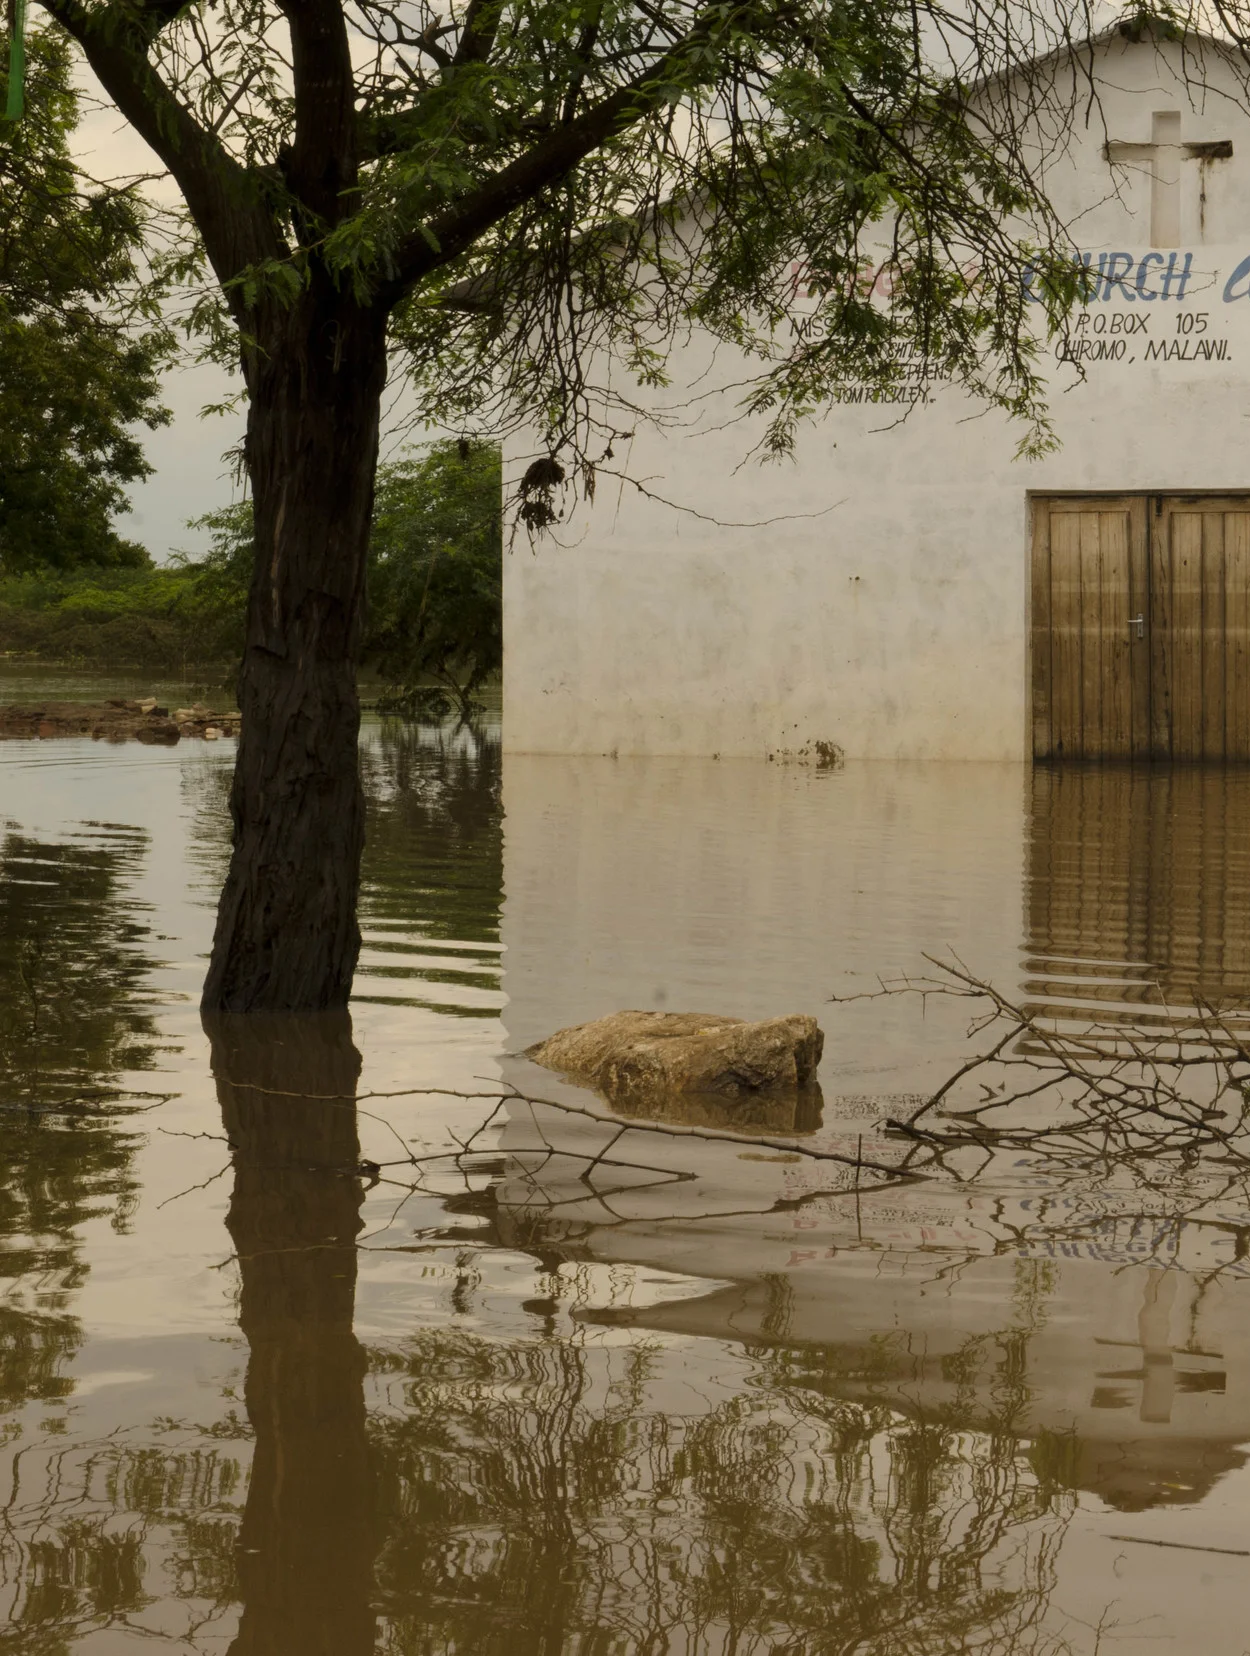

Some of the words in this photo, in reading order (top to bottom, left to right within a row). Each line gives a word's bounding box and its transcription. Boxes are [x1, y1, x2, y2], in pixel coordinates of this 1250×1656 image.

[1021, 252, 1193, 303] CURCH
[1176, 312, 1209, 335] 105
[1144, 339, 1232, 361] MALAWI.
